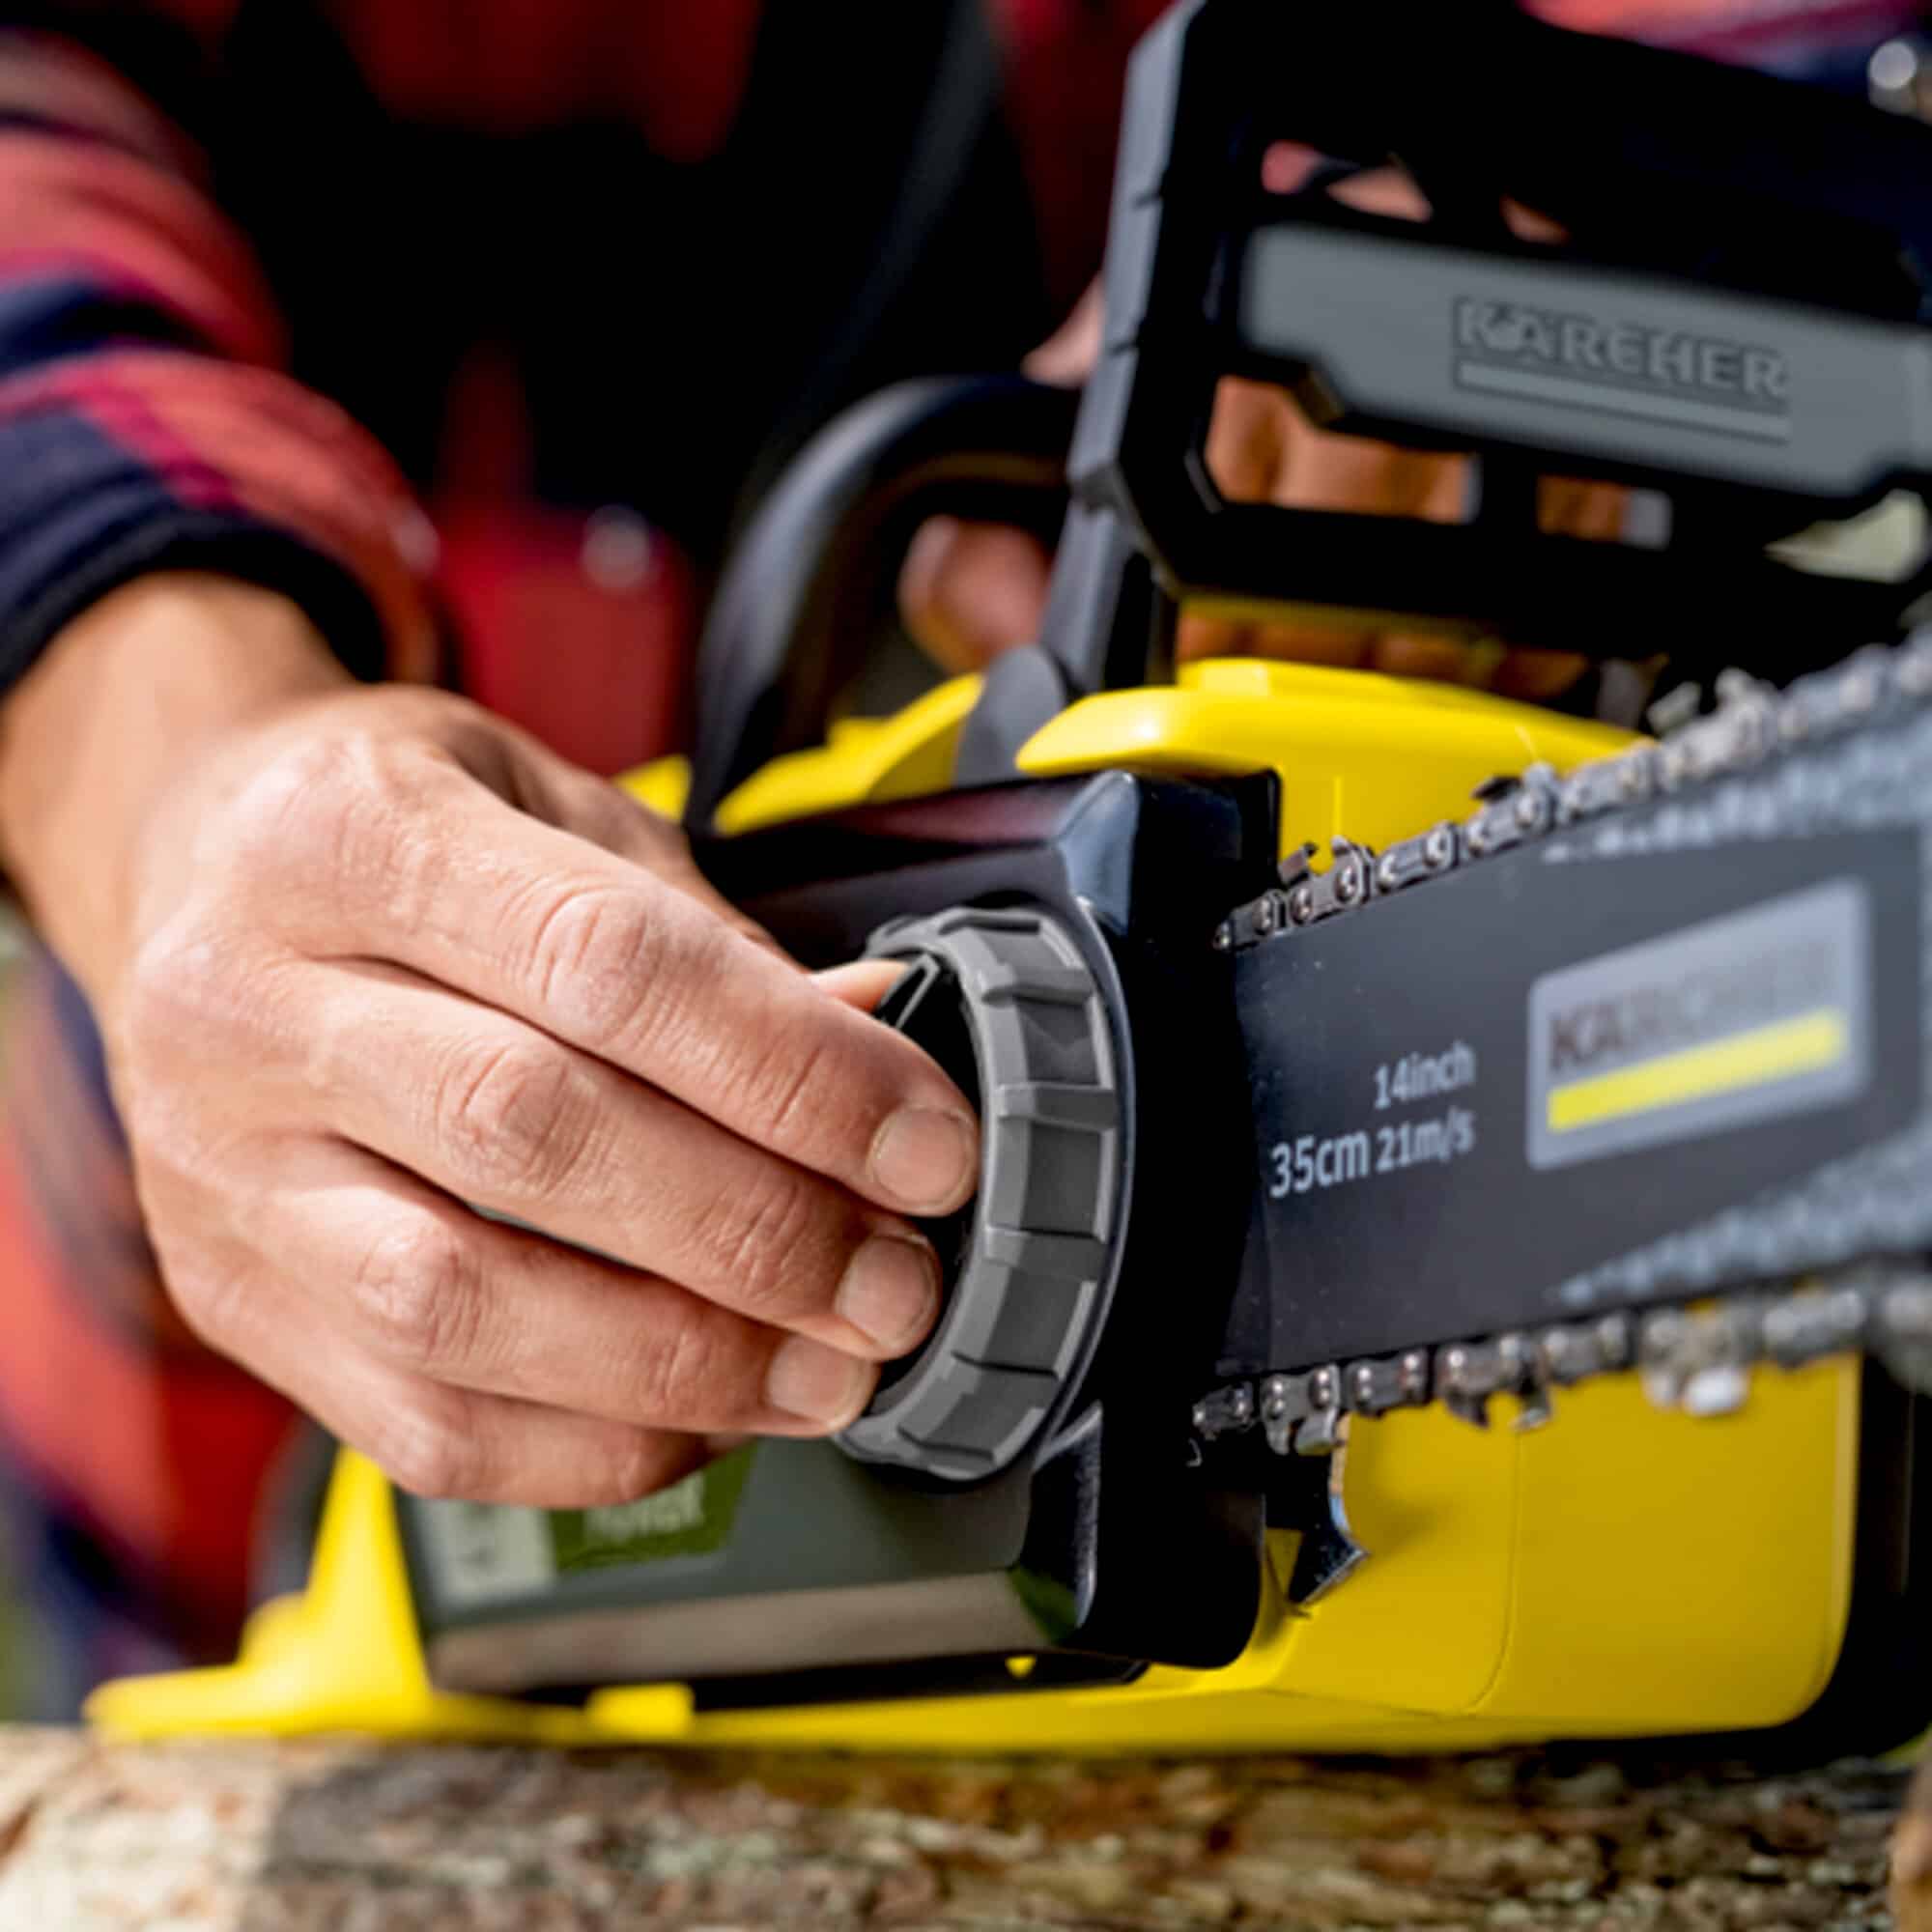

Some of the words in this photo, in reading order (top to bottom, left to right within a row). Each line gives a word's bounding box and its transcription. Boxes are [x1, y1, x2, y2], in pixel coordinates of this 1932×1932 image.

[1373, 1039, 1476, 1109] 14inch
[1269, 1130, 1371, 1198] 35cm
[1376, 1105, 1476, 1173] 21m/s
